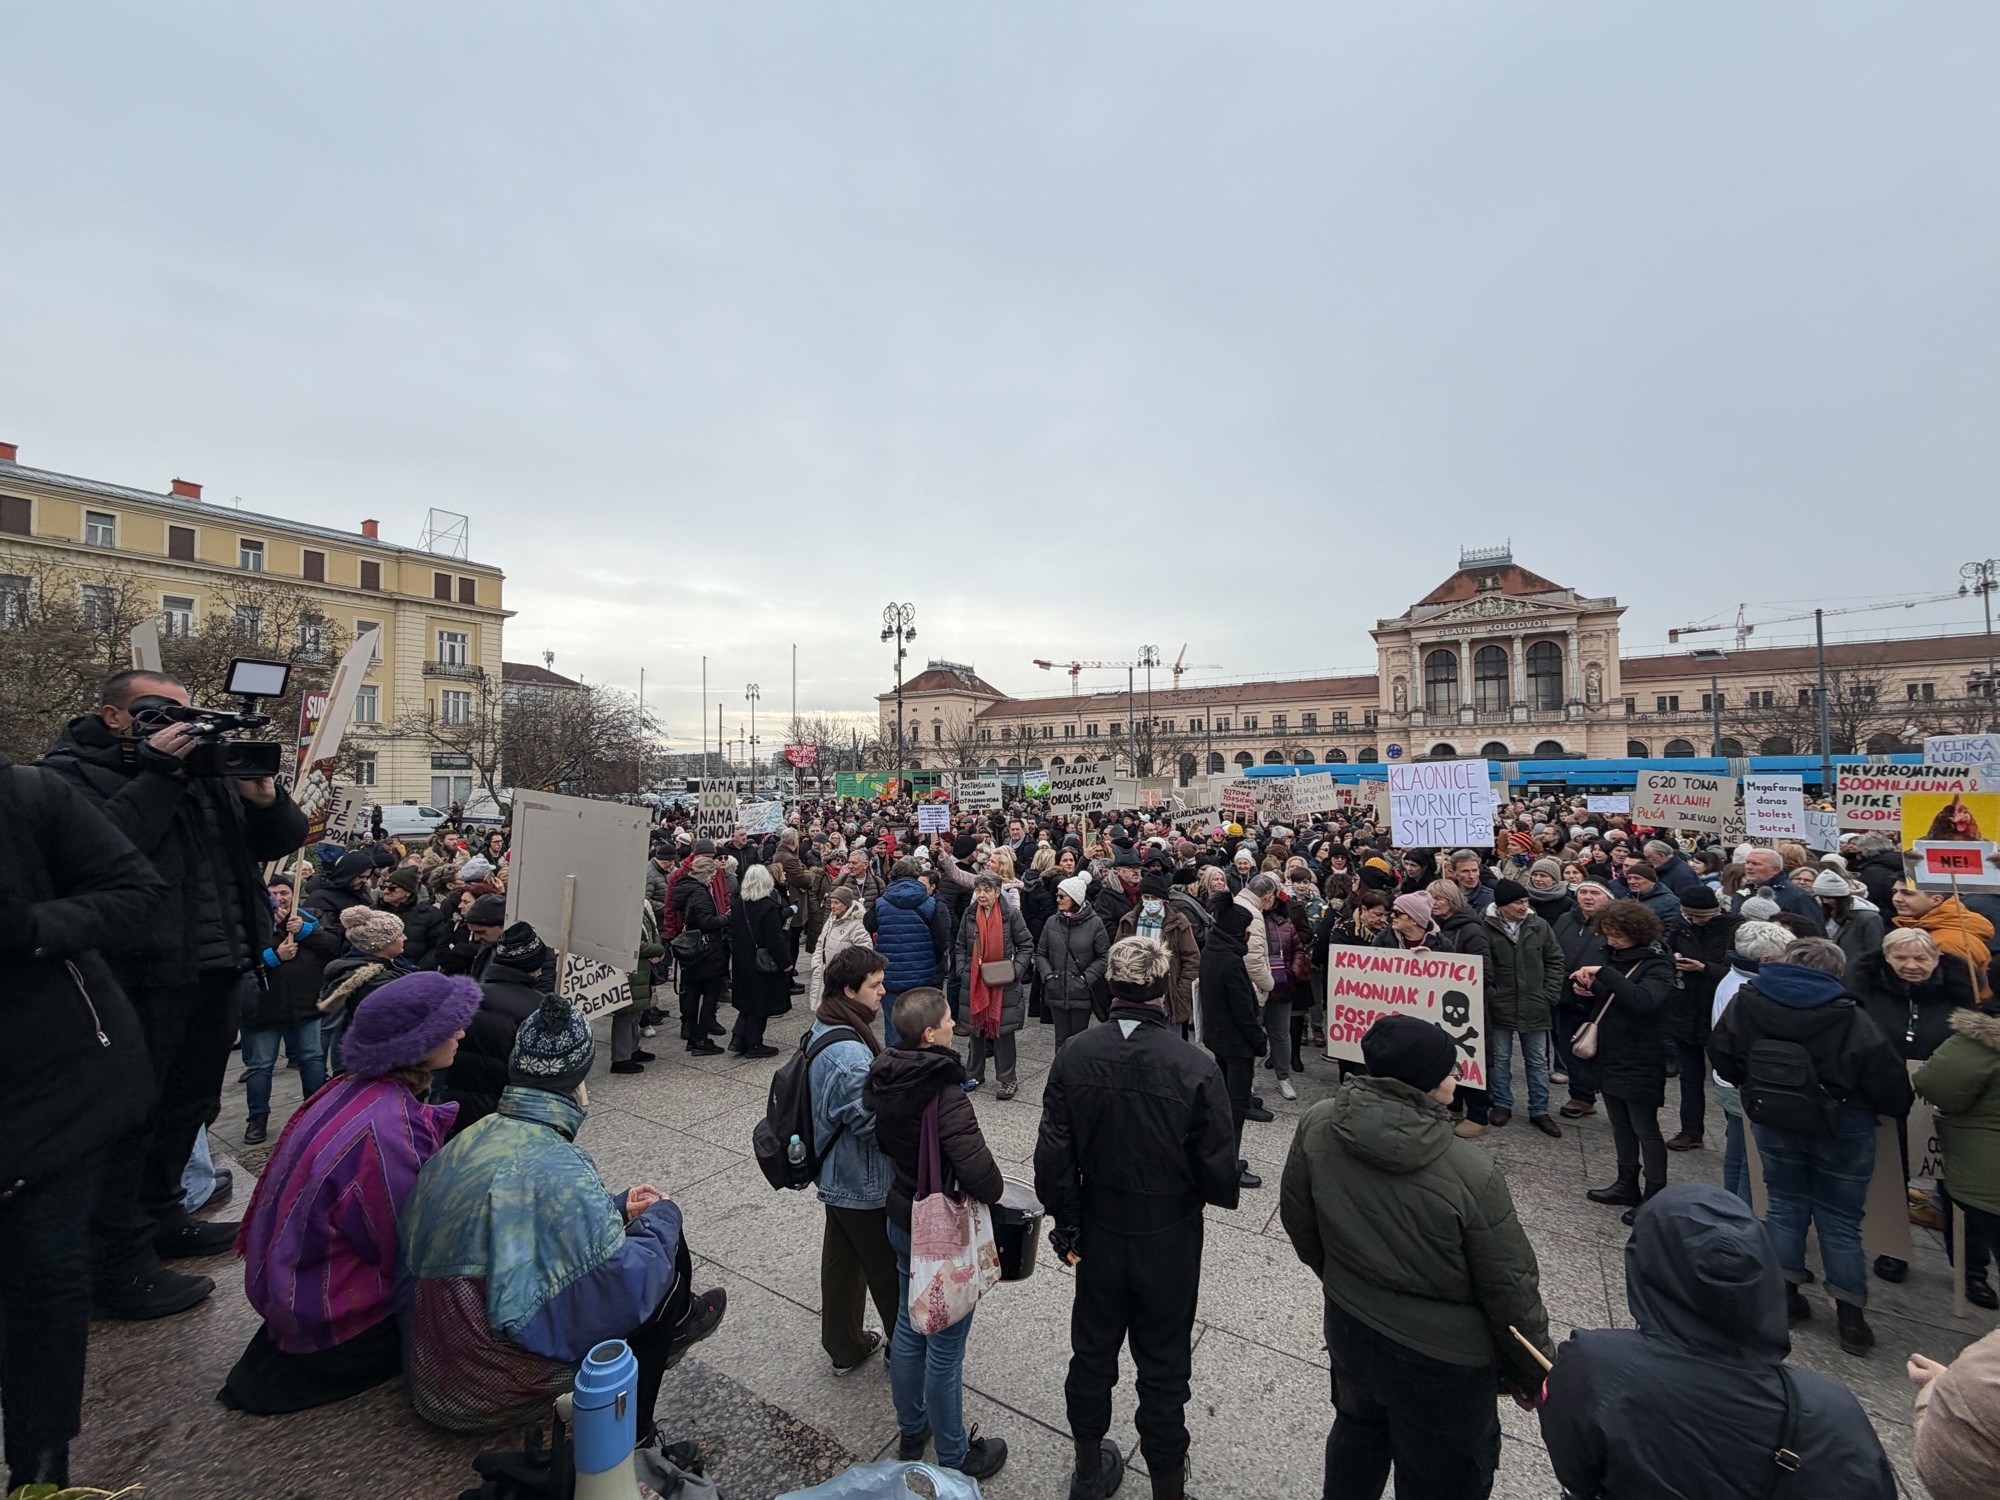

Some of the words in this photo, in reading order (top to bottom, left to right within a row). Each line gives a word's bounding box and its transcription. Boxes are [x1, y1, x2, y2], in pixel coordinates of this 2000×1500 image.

[1437, 626, 1476, 637] GLAVNI
[1486, 619, 1551, 632] KOLODVOR
[1931, 739, 1994, 752] VELIKA
[1932, 752, 1994, 763] LUDINA
[1057, 763, 1099, 776] TRAJNE
[1839, 764, 1970, 778] NEVJEROJATNIH
[1096, 775, 1107, 785] ZA
[1390, 763, 1478, 791] KLAONICE
[1648, 775, 1677, 789] 620
[1683, 777, 1718, 791] TONA
[701, 780, 734, 793] VAMA
[1050, 791, 1081, 806] OKOLIŠ
[1091, 787, 1113, 802] KORIST
[1652, 793, 1711, 808] ZAKLANIH
[1756, 796, 1788, 805] danas
[1842, 794, 1893, 808] PITKE
[1070, 801, 1103, 813] PROFITA
[1392, 792, 1481, 817] TVORNICE
[699, 809, 733, 824] NAMA
[699, 823, 736, 840] GNOJ!
[1400, 817, 1469, 846] SMRTI
[1759, 824, 1796, 833] sutra!
[1723, 835, 1738, 844] NE
[1940, 855, 1969, 868] NE!
[1334, 976, 1420, 1005] AMONIJAK
[1427, 990, 1435, 1008] I
